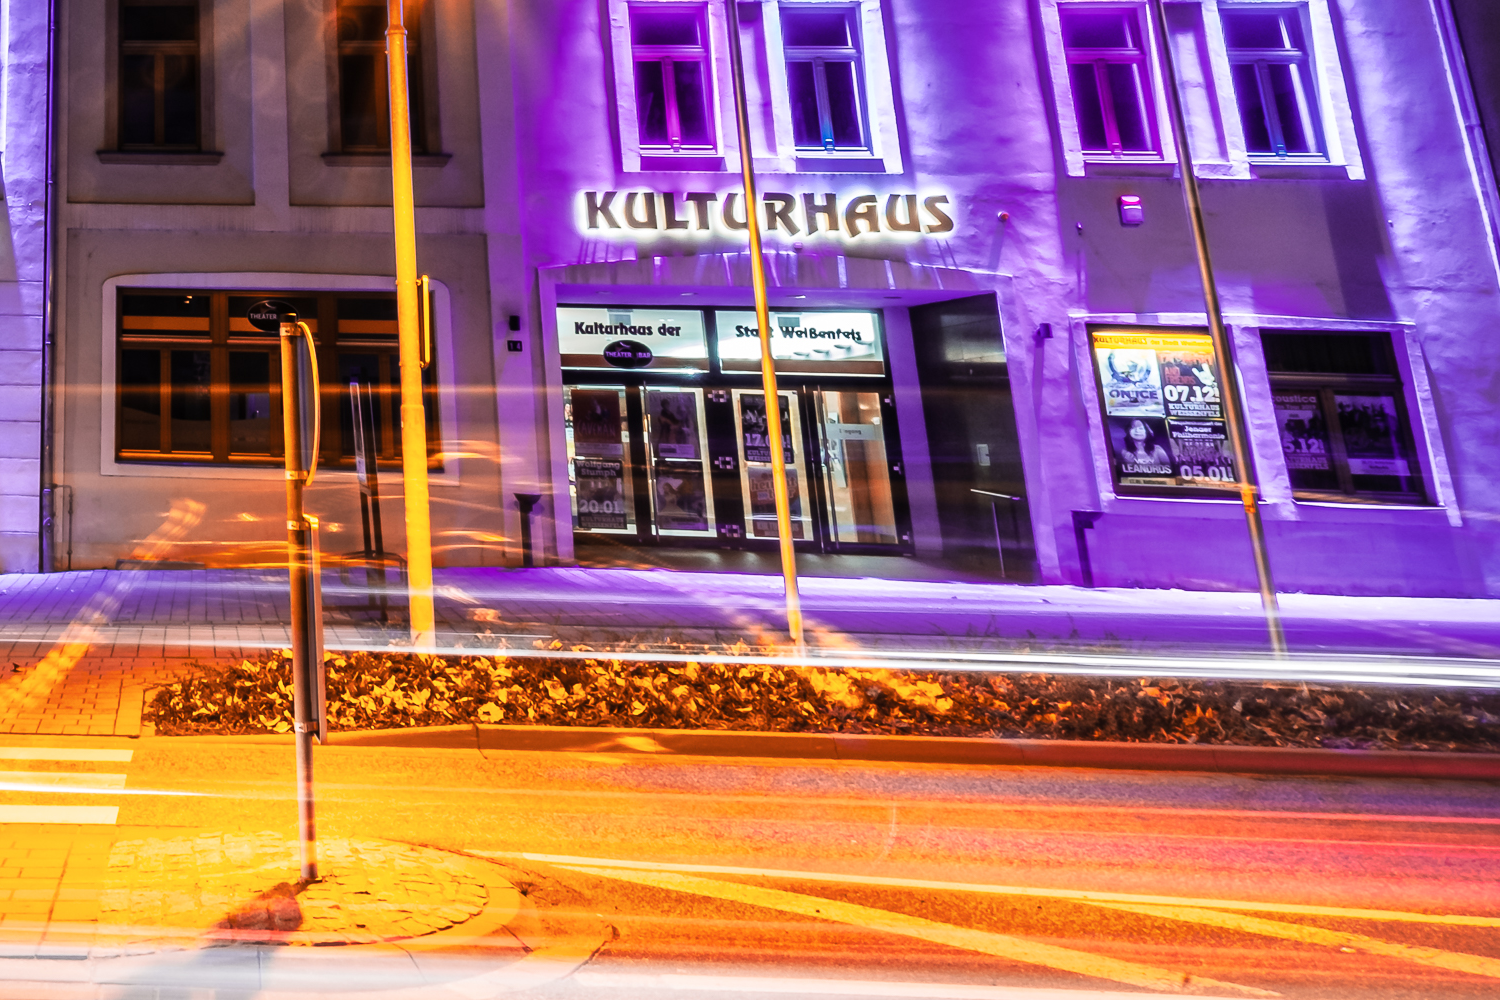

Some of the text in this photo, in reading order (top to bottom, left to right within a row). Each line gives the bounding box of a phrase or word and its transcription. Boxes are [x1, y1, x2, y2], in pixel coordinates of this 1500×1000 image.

[584, 190, 955, 239] KULTURHAUS
[658, 323, 682, 337] der
[606, 351, 632, 359] THEATER
[1164, 384, 1220, 402] 07.12!
[576, 460, 620, 470] Wolfgang
[1122, 464, 1172, 474] LEANDROS
[581, 468, 616, 478] Stumph
